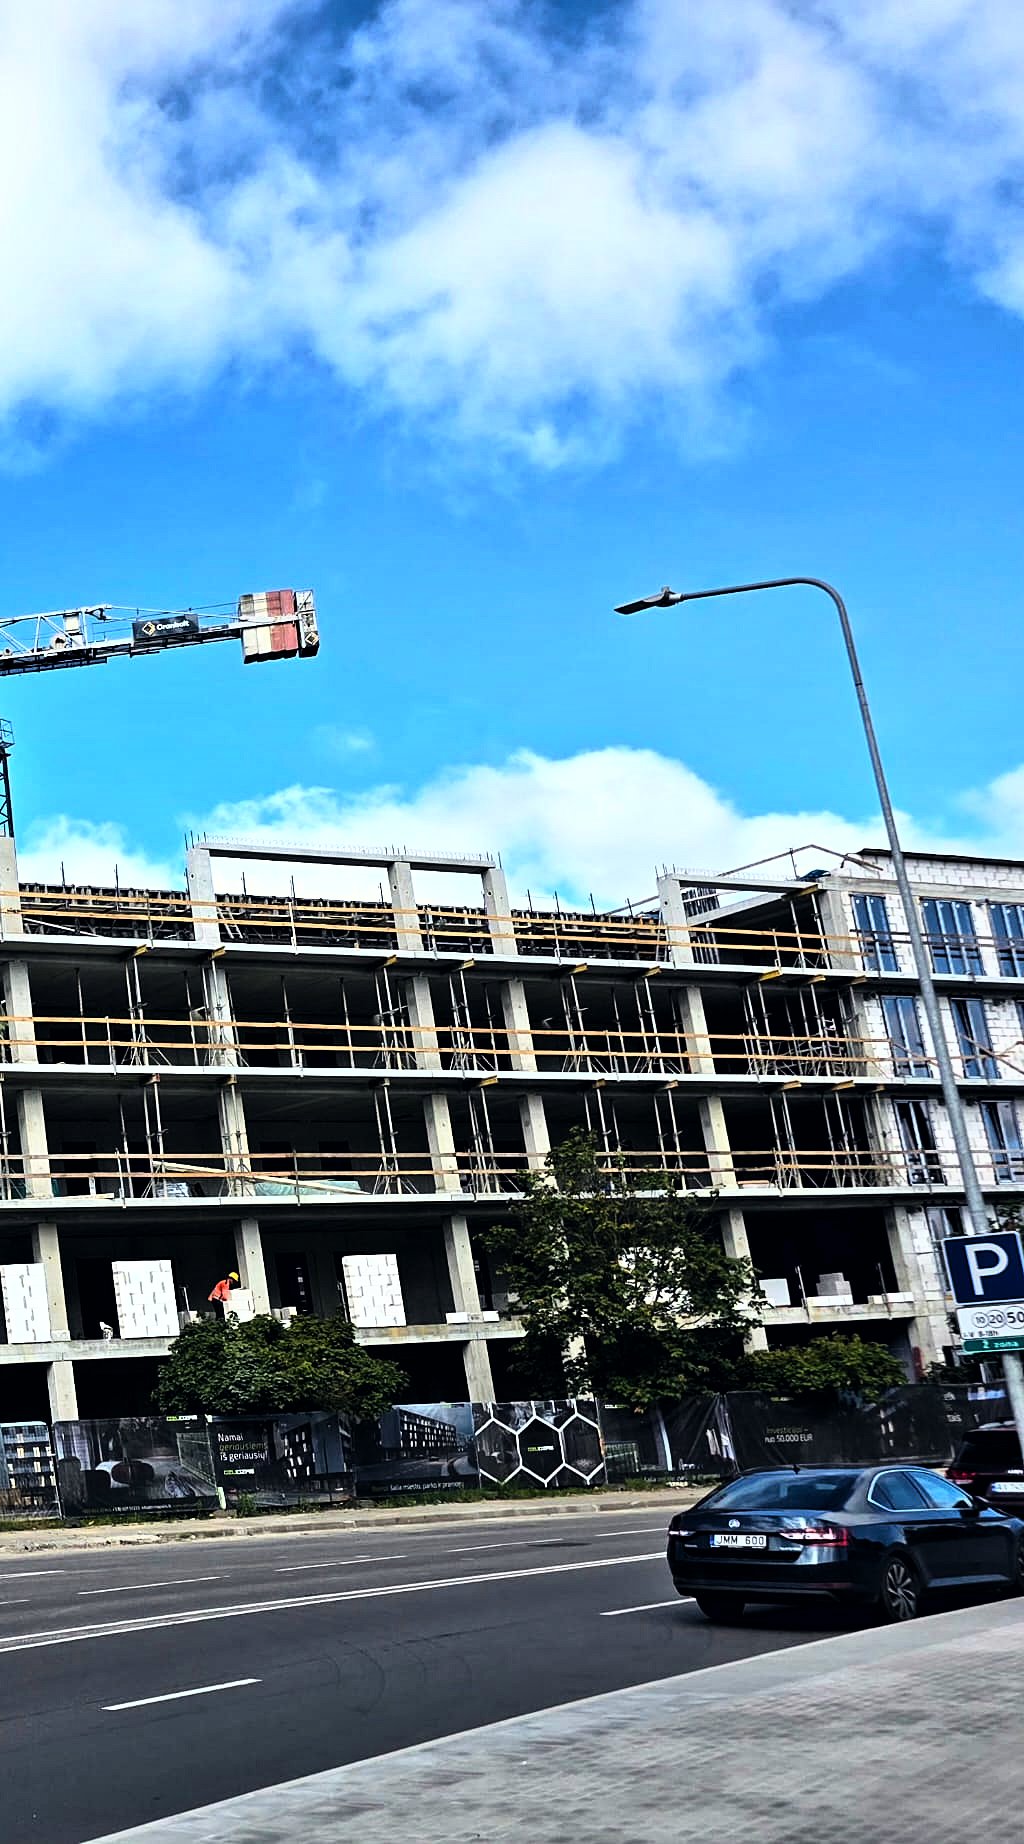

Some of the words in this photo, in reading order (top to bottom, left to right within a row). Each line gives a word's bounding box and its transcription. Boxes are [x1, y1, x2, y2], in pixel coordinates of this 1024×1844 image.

[965, 1243, 1008, 1295] P
[989, 1314, 1003, 1324] 20
[217, 1433, 244, 1442] Namai
[717, 1535, 738, 1545] JMM
[745, 1536, 764, 1546] 600
